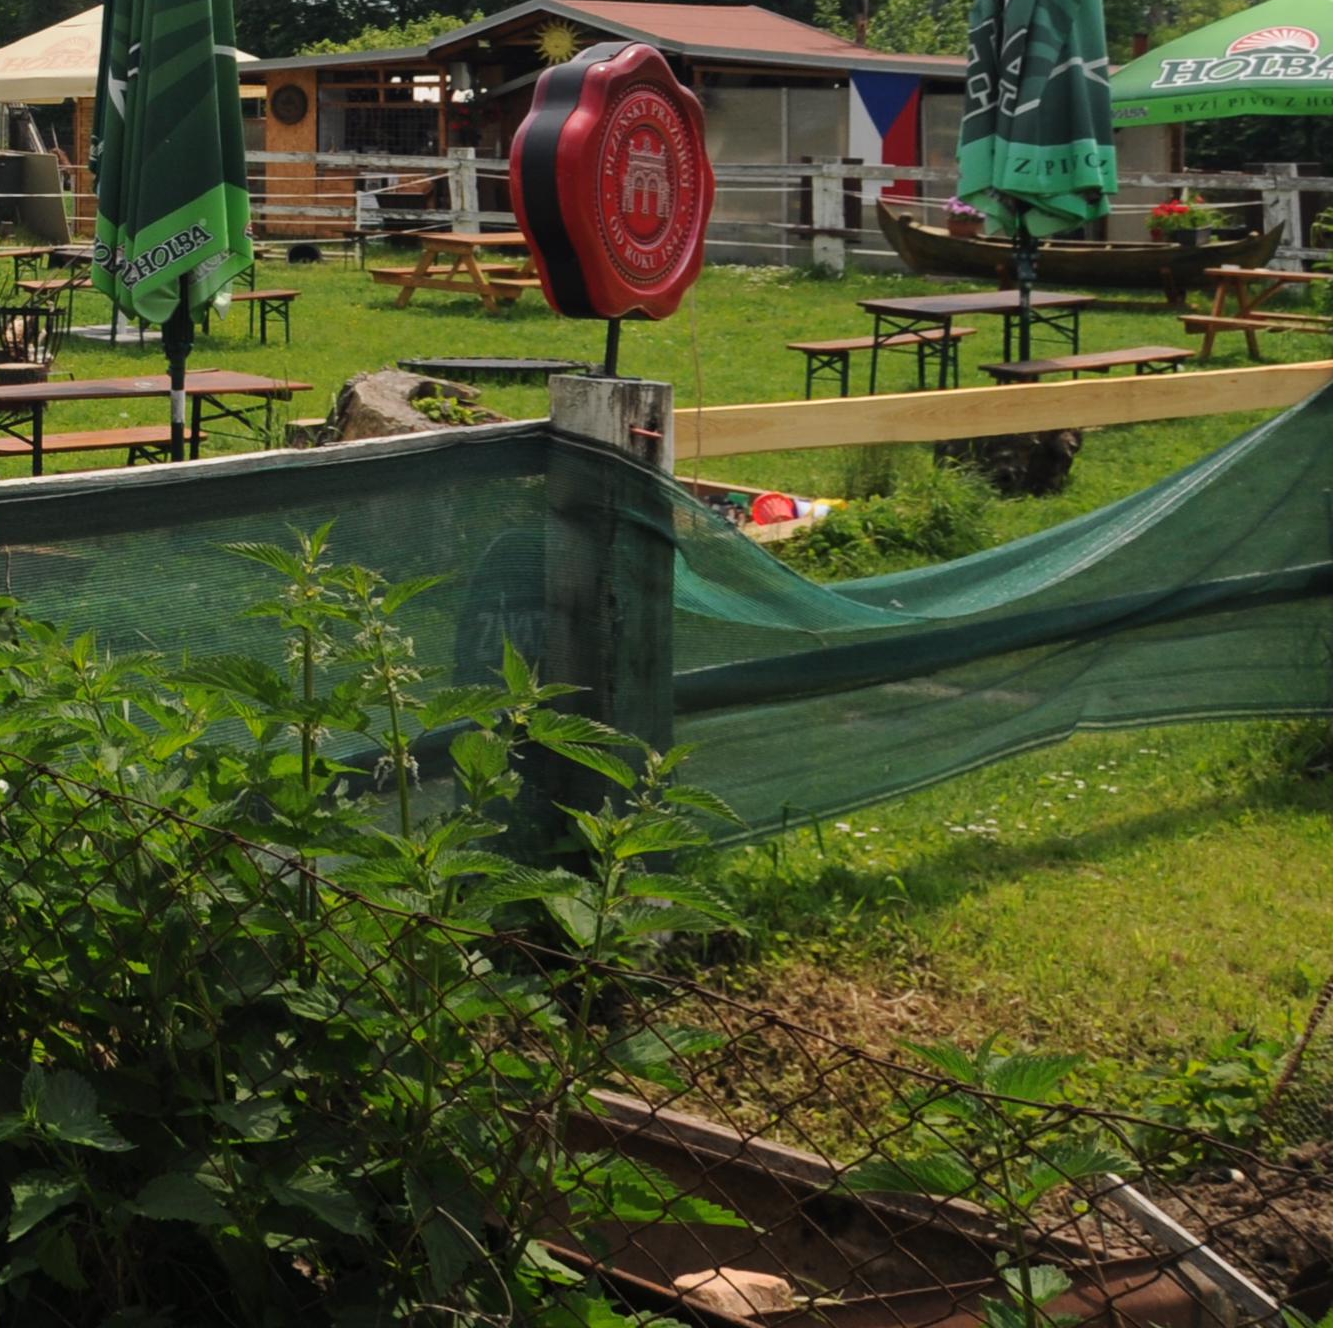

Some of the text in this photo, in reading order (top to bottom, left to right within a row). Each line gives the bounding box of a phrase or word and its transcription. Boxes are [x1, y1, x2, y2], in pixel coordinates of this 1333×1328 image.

[1229, 96, 1274, 110] PIVO
[136, 223, 213, 281] HOLBA
[610, 215, 626, 246] OD
[624, 249, 660, 269] ROKU
